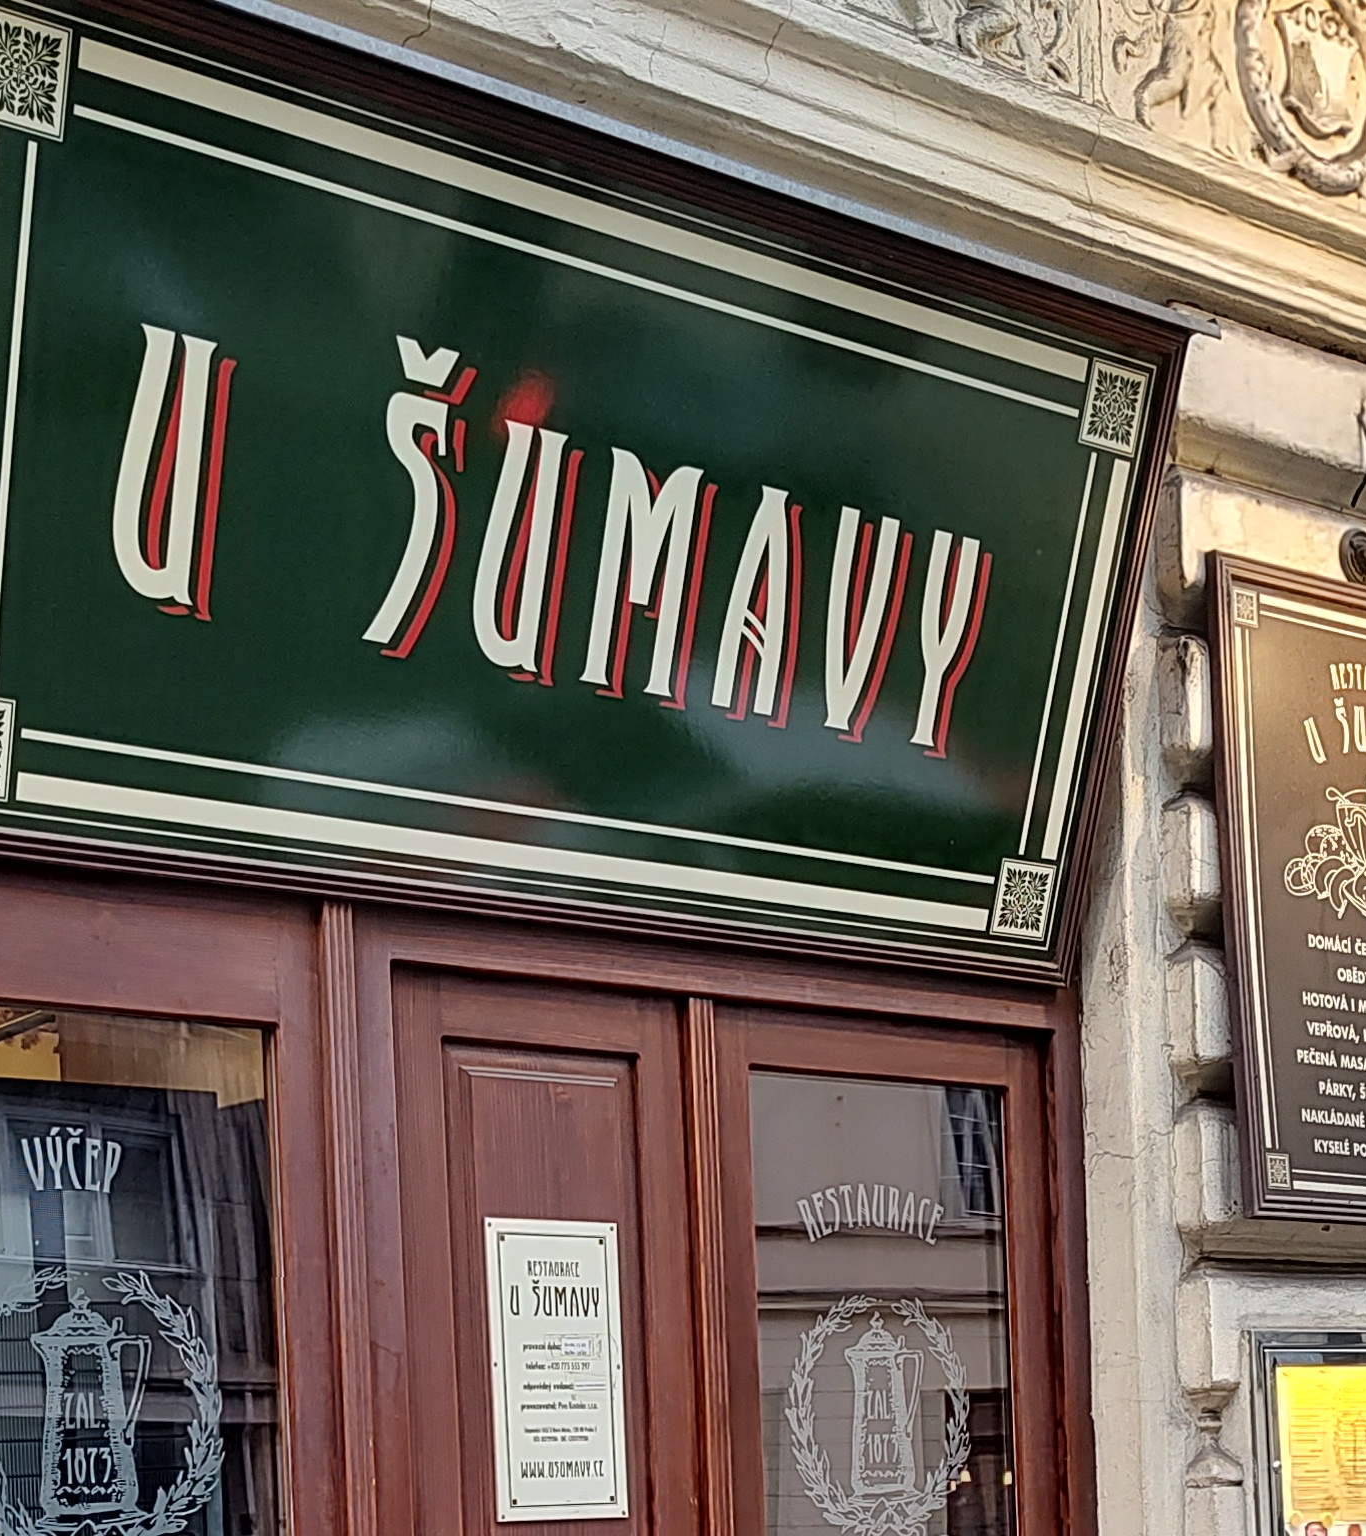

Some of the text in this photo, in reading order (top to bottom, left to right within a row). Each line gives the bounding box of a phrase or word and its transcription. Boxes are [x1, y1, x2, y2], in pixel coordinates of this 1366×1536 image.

[112, 323, 993, 759] U ŠUMAVY
[1303, 717, 1327, 764] U
[1308, 934, 1351, 953] DOMÁCÍ
[1302, 991, 1348, 1011] HOTOVÁ
[1351, 998, 1355, 1011] I
[1307, 1021, 1359, 1043] VEPŘOVÁ,
[1297, 1047, 1337, 1068] PEČENÁ
[1319, 1079, 1356, 1101] PÁRKY,
[1302, 1108, 1365, 1128] NAKLÁDANÉ
[1314, 1138, 1350, 1156] KYSELÉ
[21, 1127, 122, 1193] VÝČEP
[797, 1184, 944, 1245] RESTAURACE
[527, 1260, 580, 1278] RESTAURACE
[510, 1279, 600, 1318] U ŠUMAVY
[520, 1460, 605, 1481] WWW.USUMAVY.CZ
